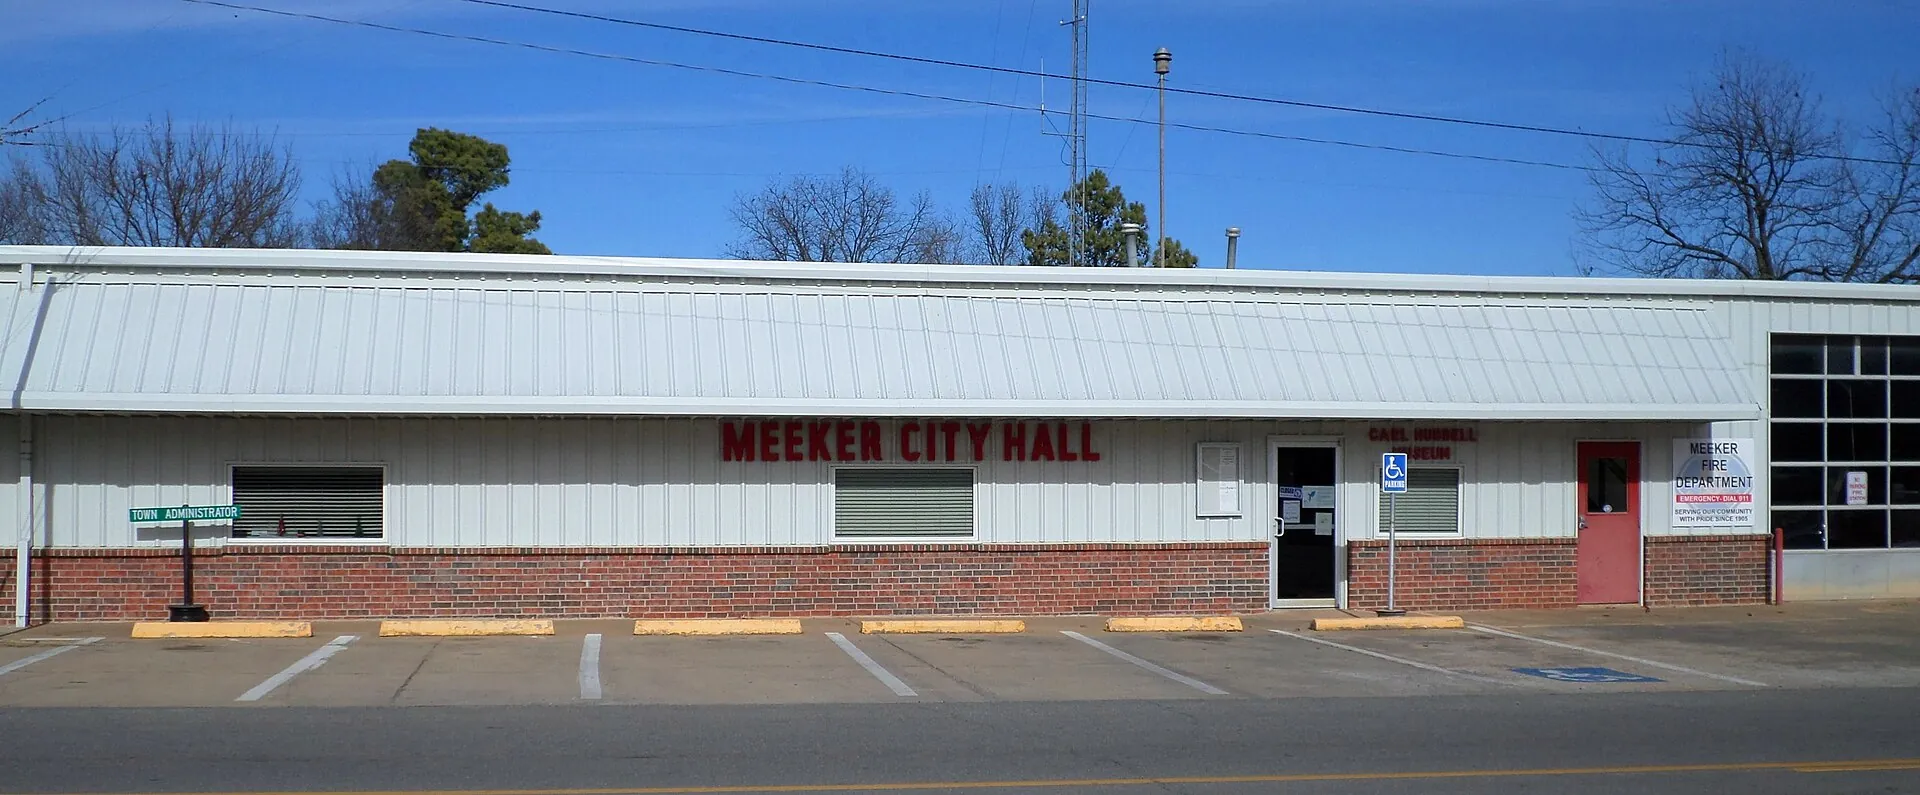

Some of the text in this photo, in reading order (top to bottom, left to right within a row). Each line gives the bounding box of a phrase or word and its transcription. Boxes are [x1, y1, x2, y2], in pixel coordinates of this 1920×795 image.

[1368, 427, 1478, 442] CARL HUBBELL
[722, 420, 1101, 462] MEEKER CITY HALL
[1690, 442, 1738, 454] MEEKER
[1702, 459, 1727, 471] FIRE
[1385, 480, 1405, 488] PARKING
[1676, 476, 1753, 488] DEPARTMENT
[132, 506, 238, 520] TOWN ADMINISTRATOR
